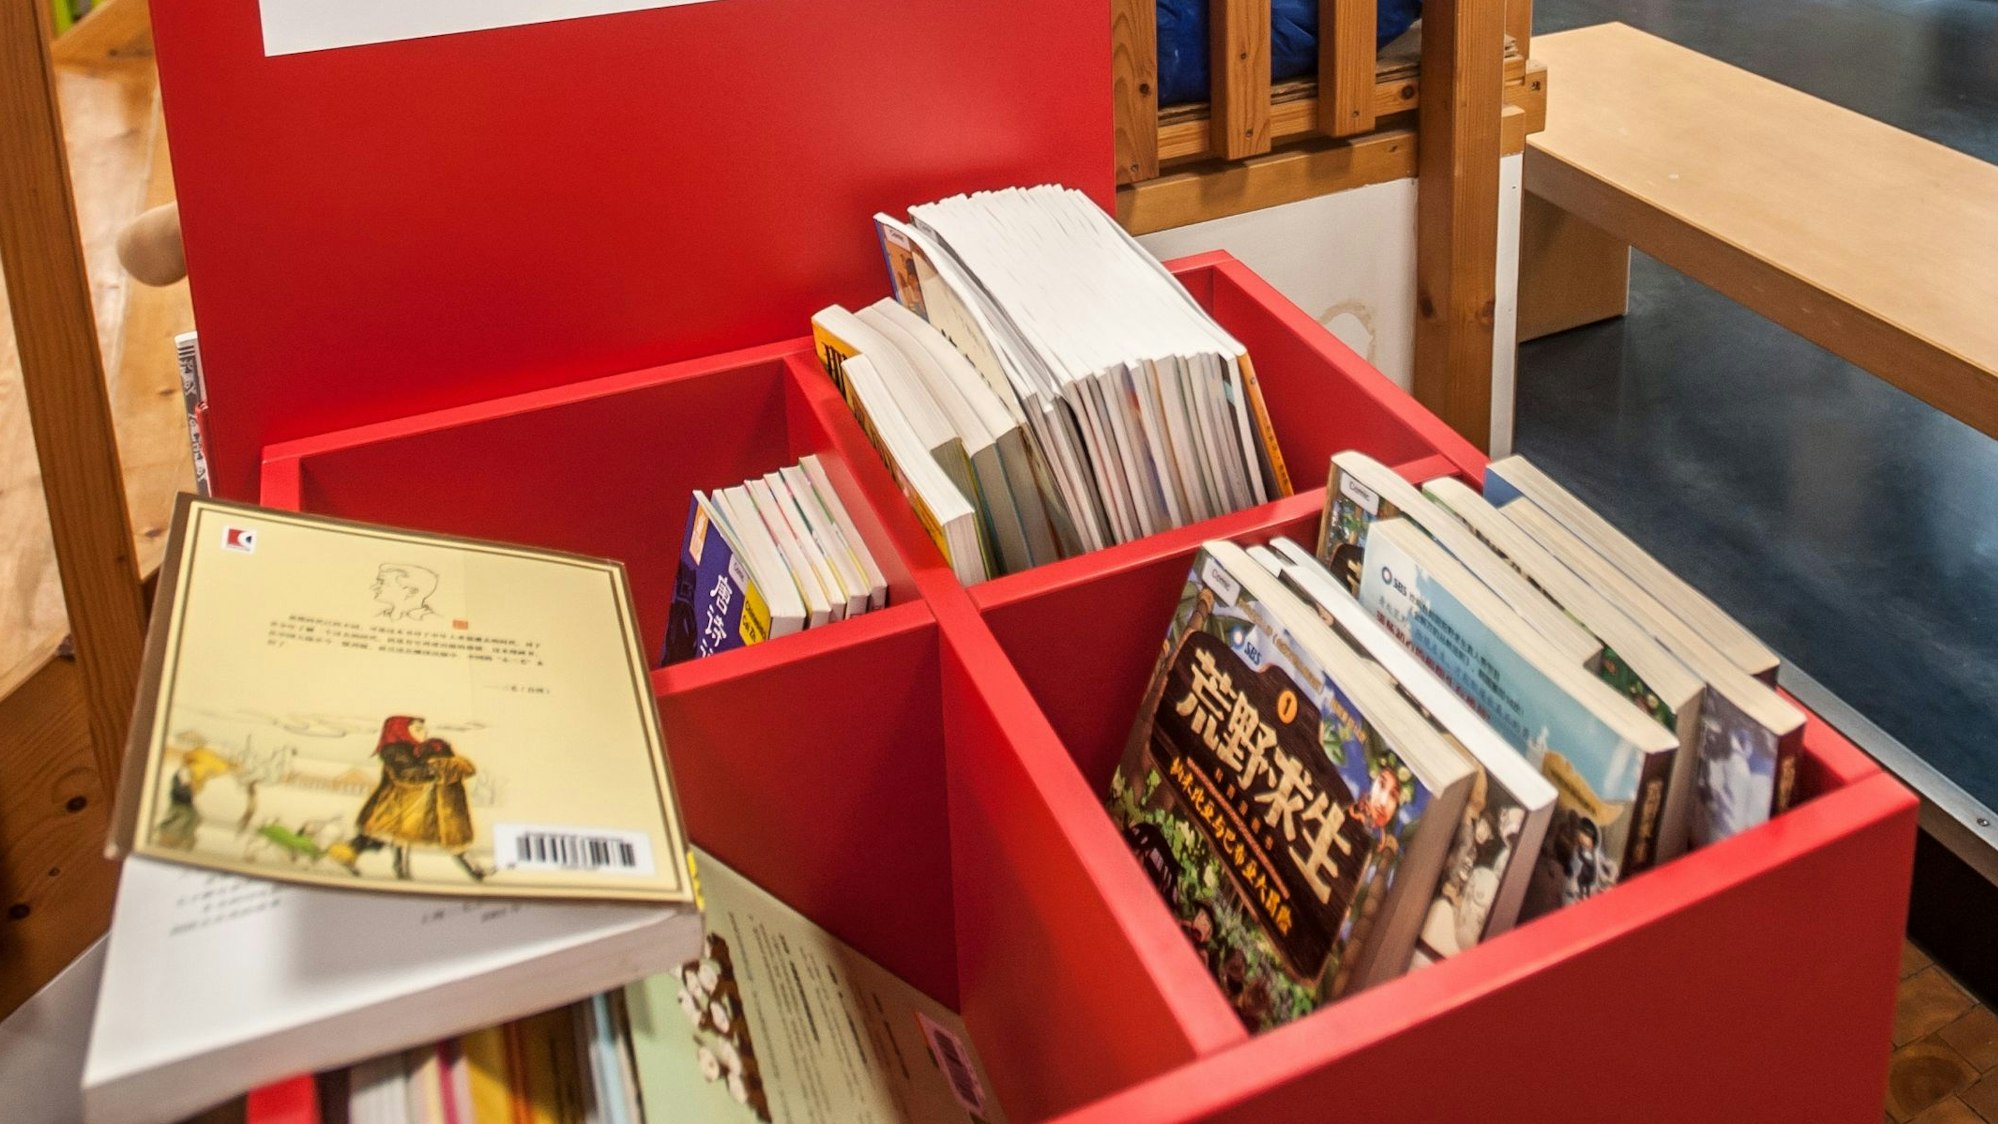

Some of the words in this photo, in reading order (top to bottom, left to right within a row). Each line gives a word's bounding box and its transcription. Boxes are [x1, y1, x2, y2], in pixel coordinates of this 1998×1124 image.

[1211, 568, 1231, 592] Comic
[1243, 640, 1262, 667] SBS
[1175, 648, 1352, 905] 荒野求生
